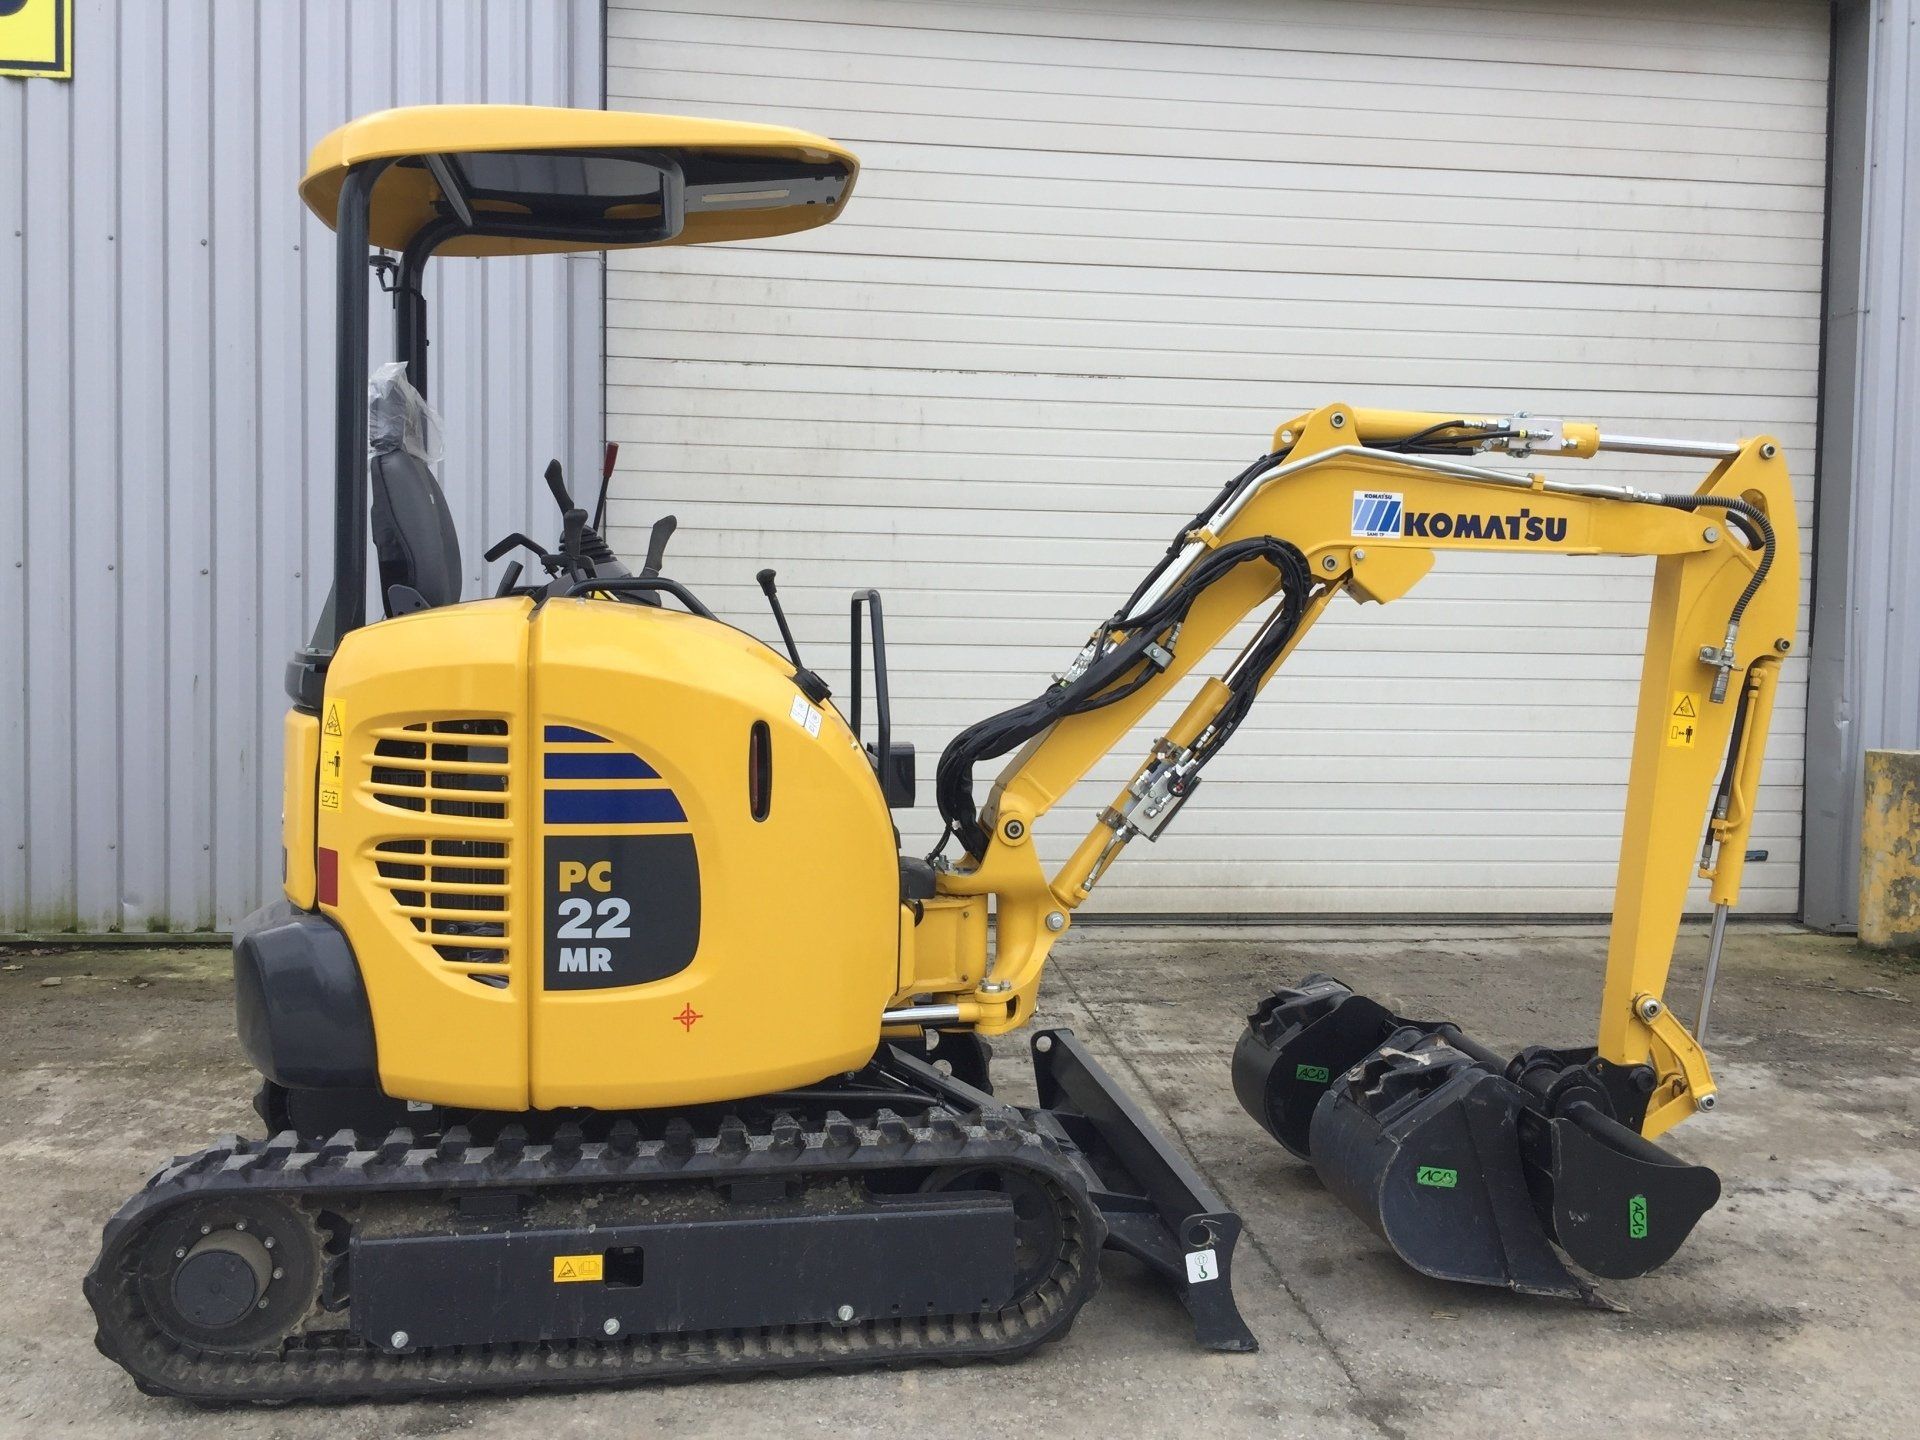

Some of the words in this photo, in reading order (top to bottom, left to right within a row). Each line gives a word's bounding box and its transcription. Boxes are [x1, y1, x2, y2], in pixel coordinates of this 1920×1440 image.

[1404, 508, 1567, 542] KOMATSU
[559, 861, 612, 892] PC
[557, 897, 631, 939] 22
[558, 947, 613, 972] MR
